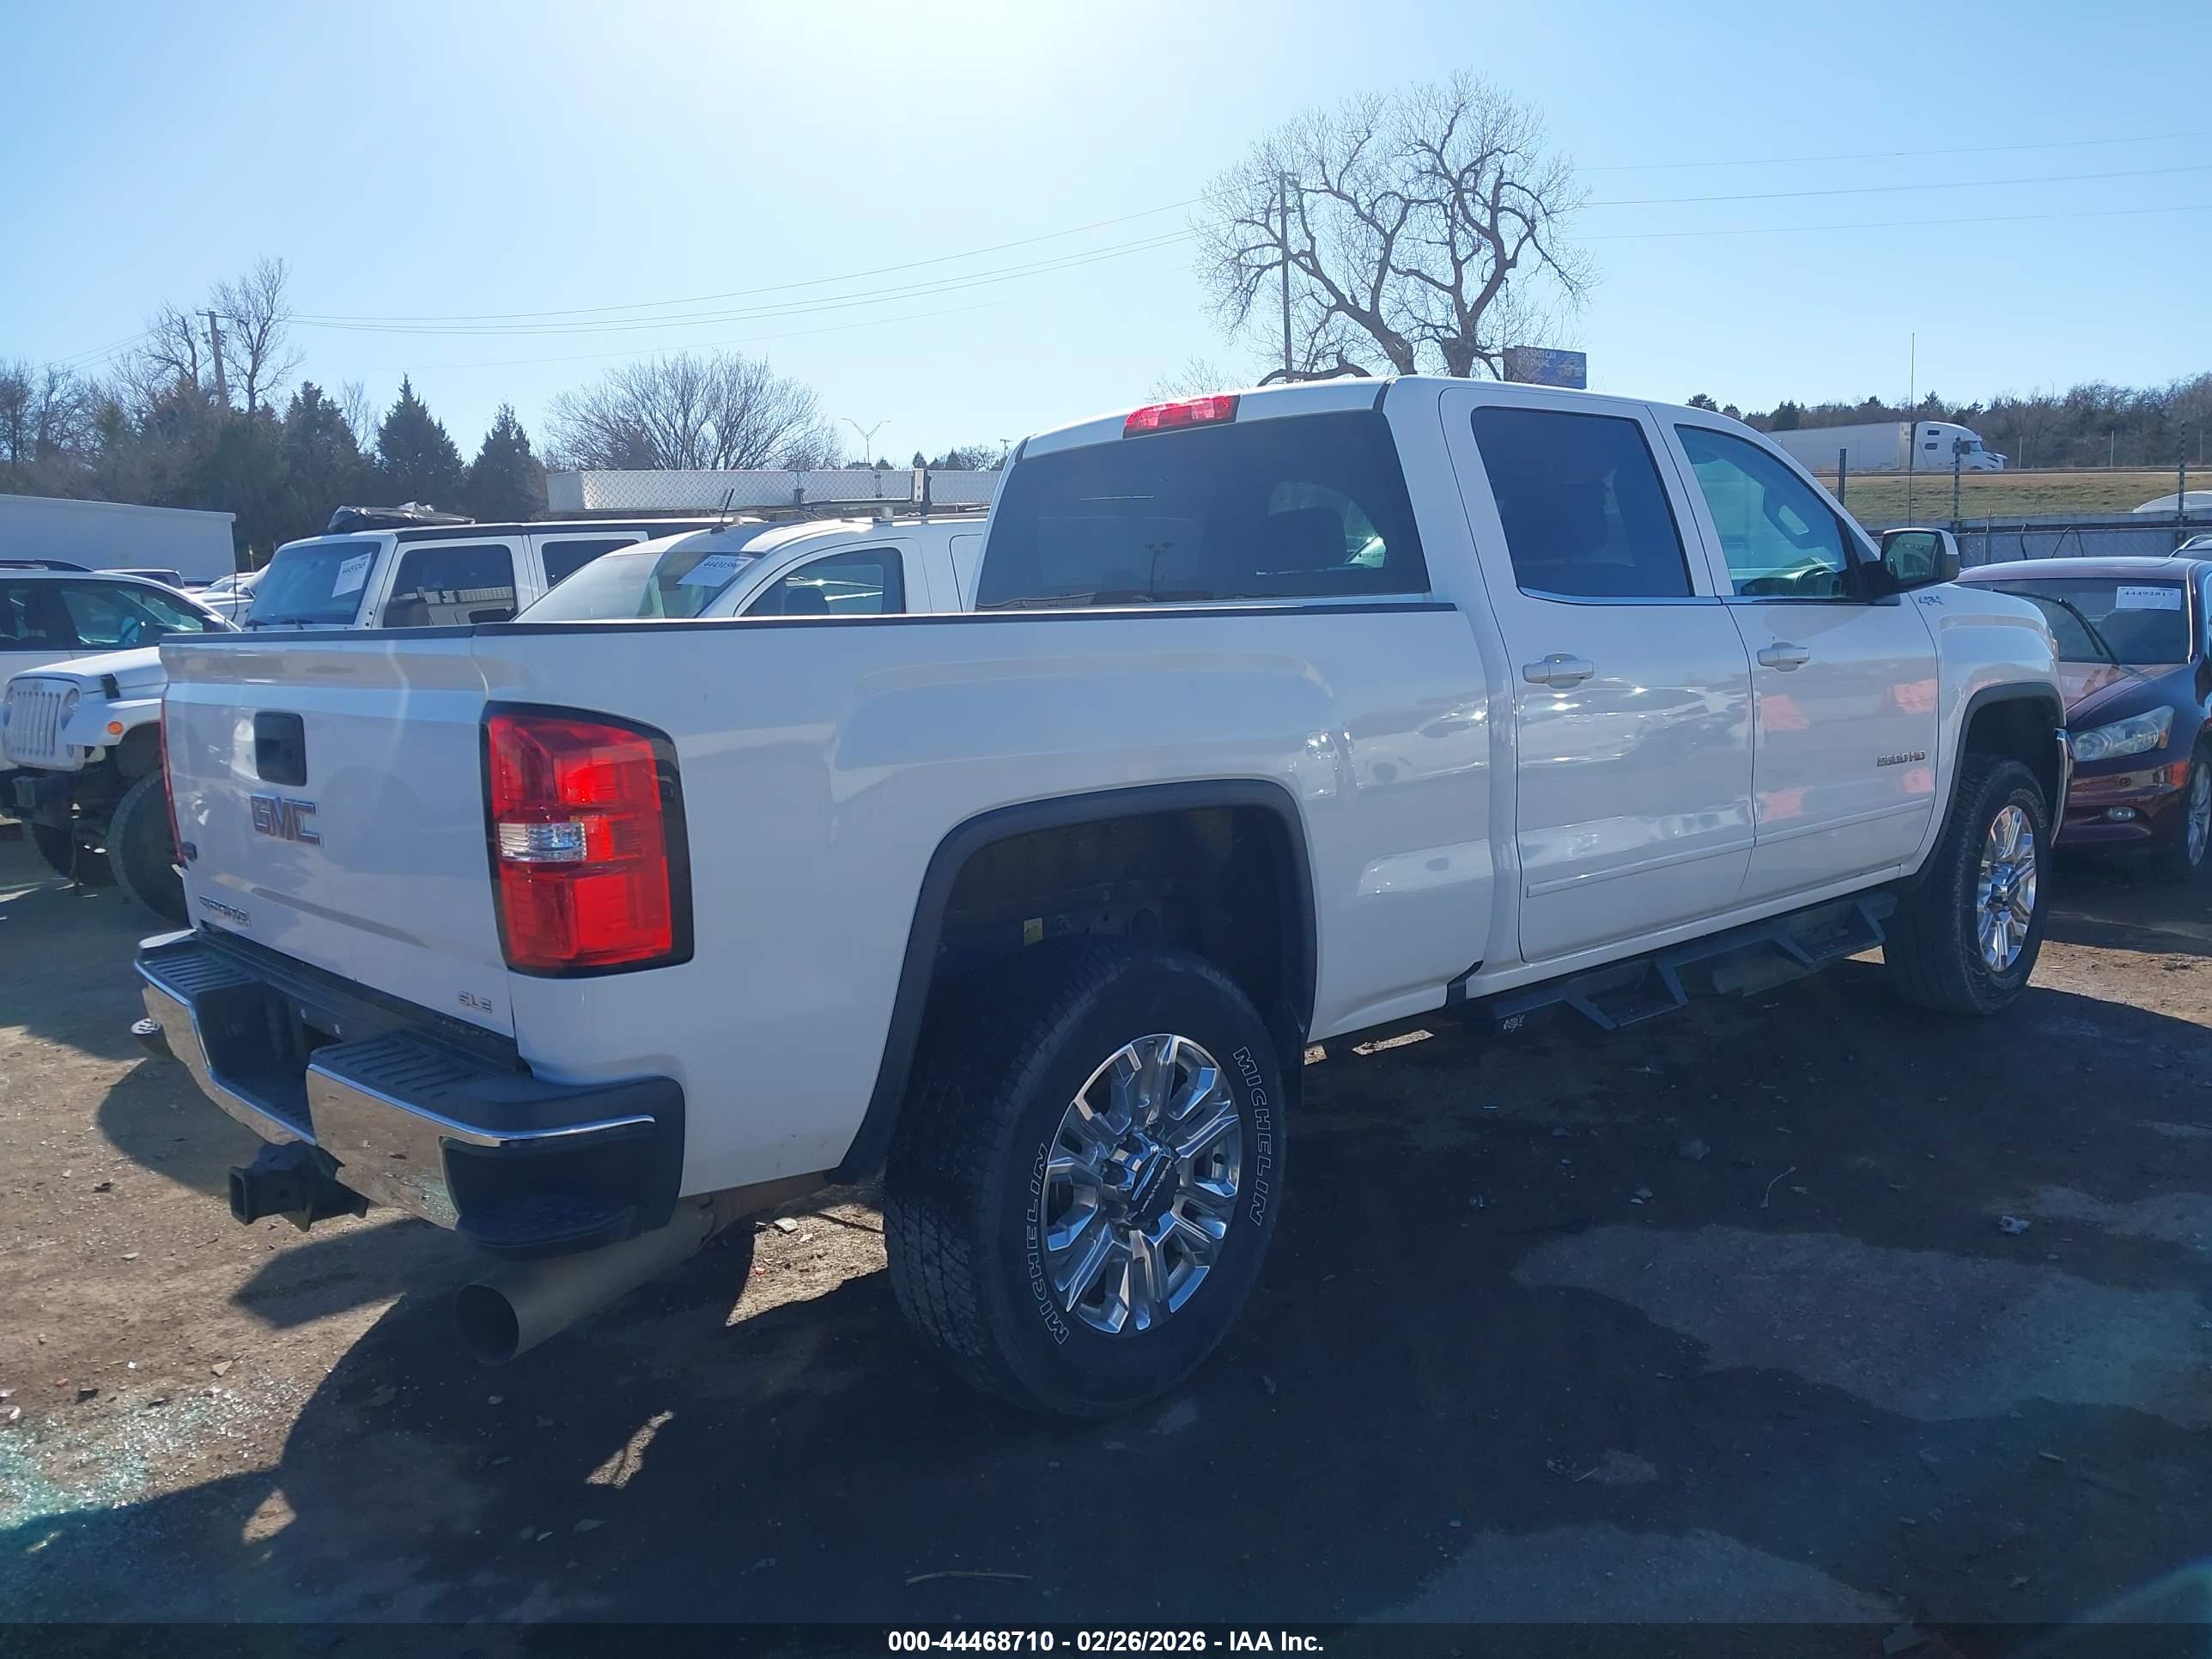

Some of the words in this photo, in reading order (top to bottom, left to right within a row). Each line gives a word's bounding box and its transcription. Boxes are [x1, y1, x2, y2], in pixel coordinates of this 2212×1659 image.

[251, 794, 323, 846] GMC
[459, 989, 493, 1014] SLE
[1233, 1046, 1273, 1226] MICHELIN
[1026, 1143, 1070, 1345] MICHELIN
